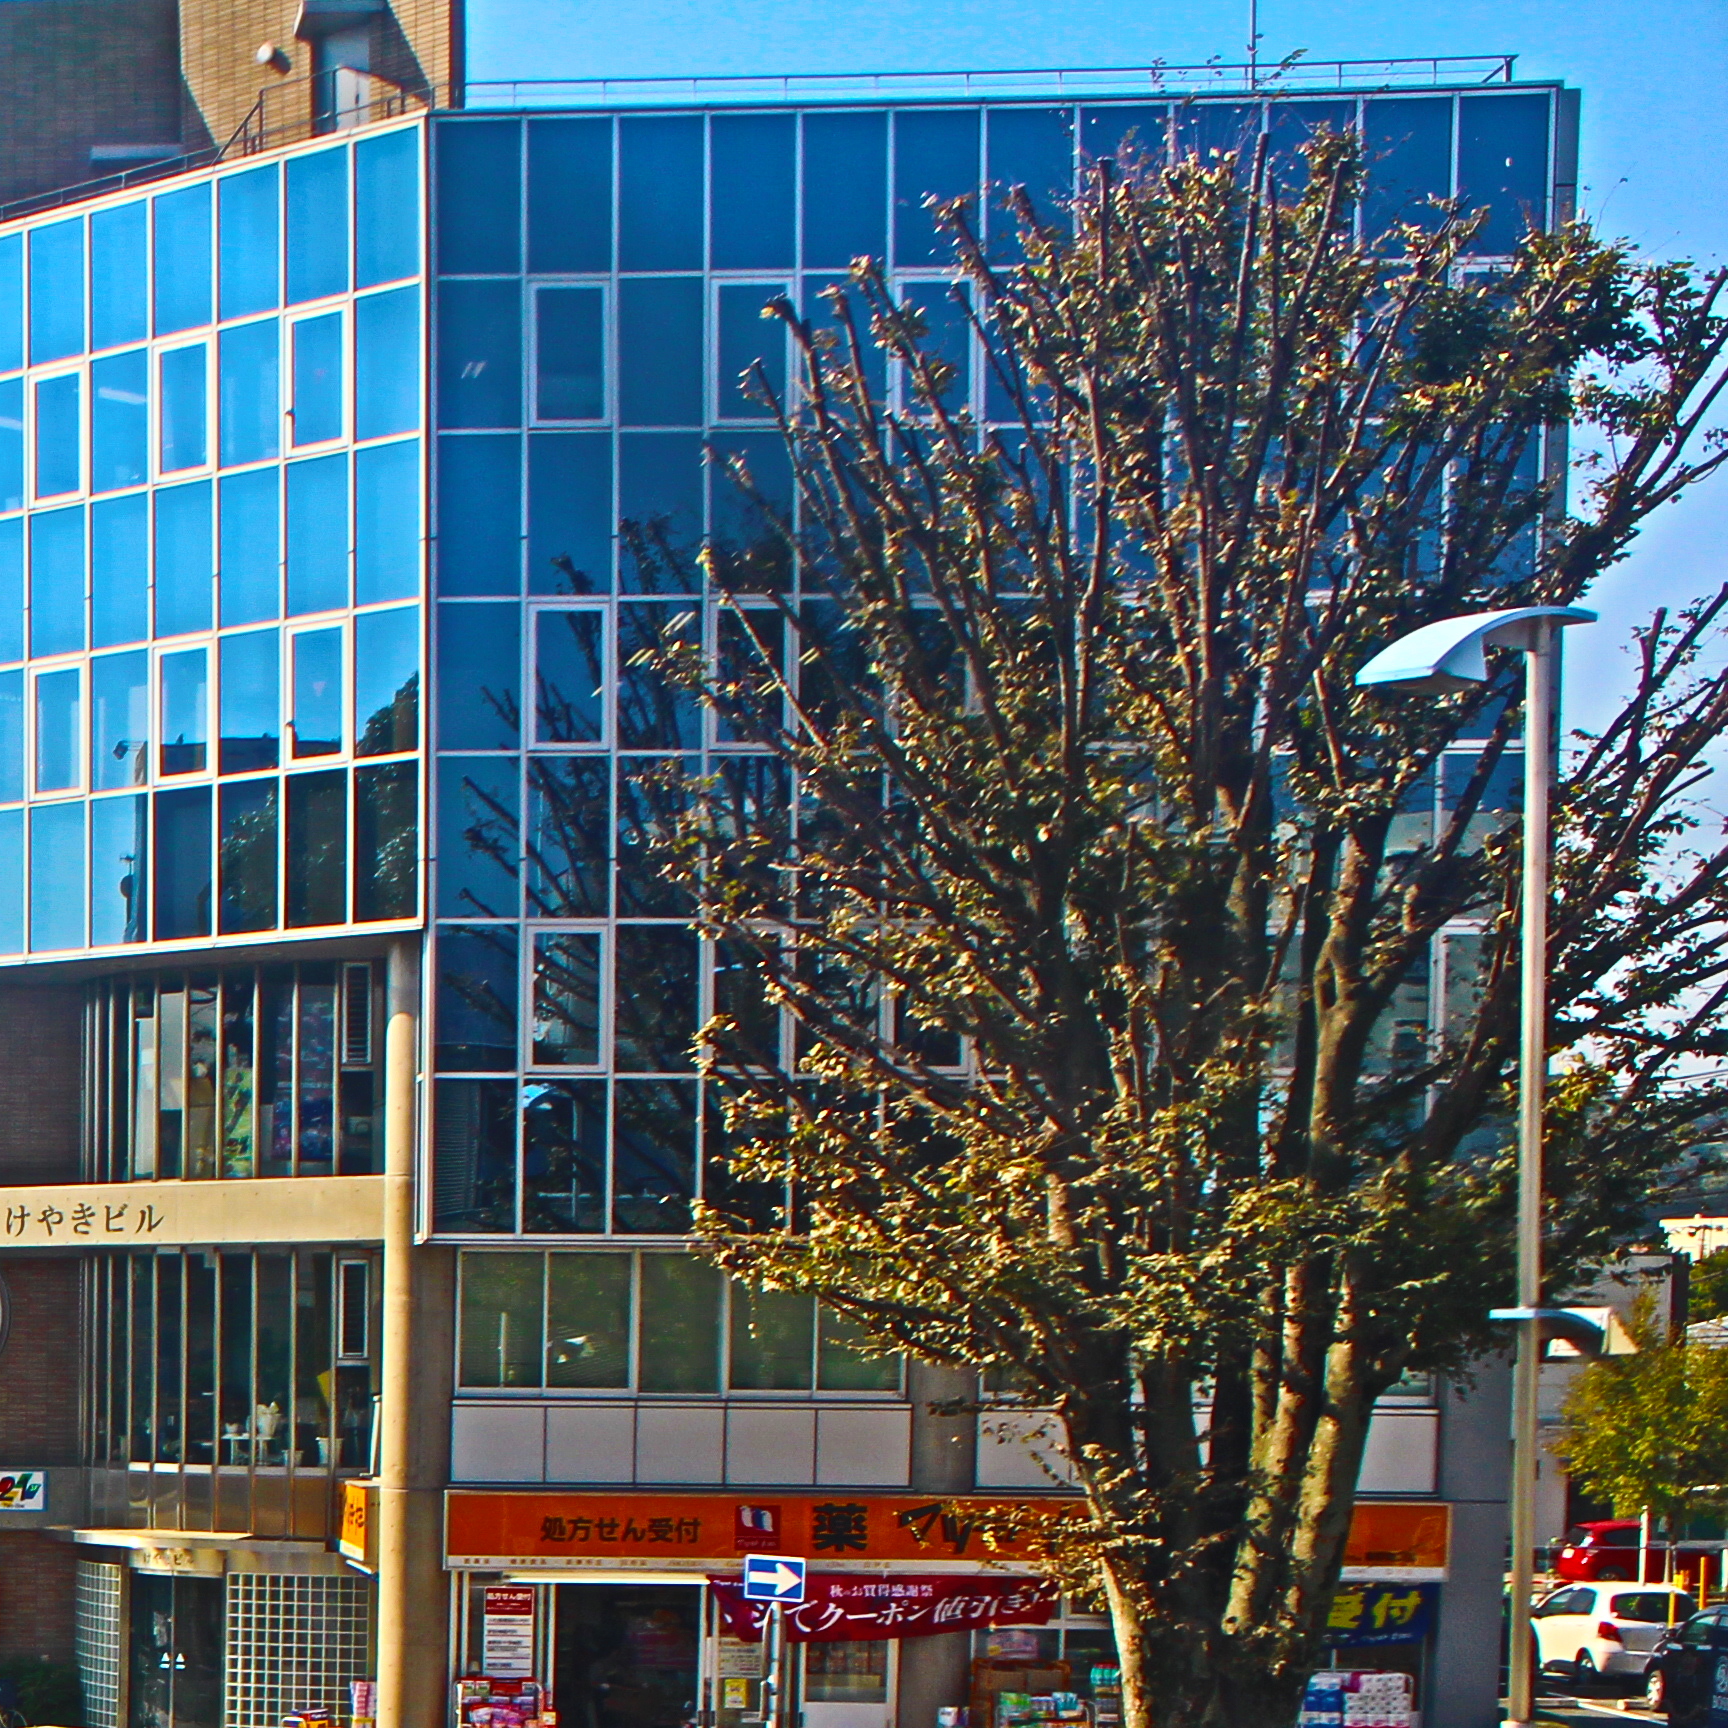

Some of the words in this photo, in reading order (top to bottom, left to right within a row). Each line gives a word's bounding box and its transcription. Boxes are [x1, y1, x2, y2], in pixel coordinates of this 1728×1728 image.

[6, 1202, 165, 1238] けやきビル
[541, 1516, 701, 1543] 処方せん受付
[812, 1503, 868, 1551] 薬
